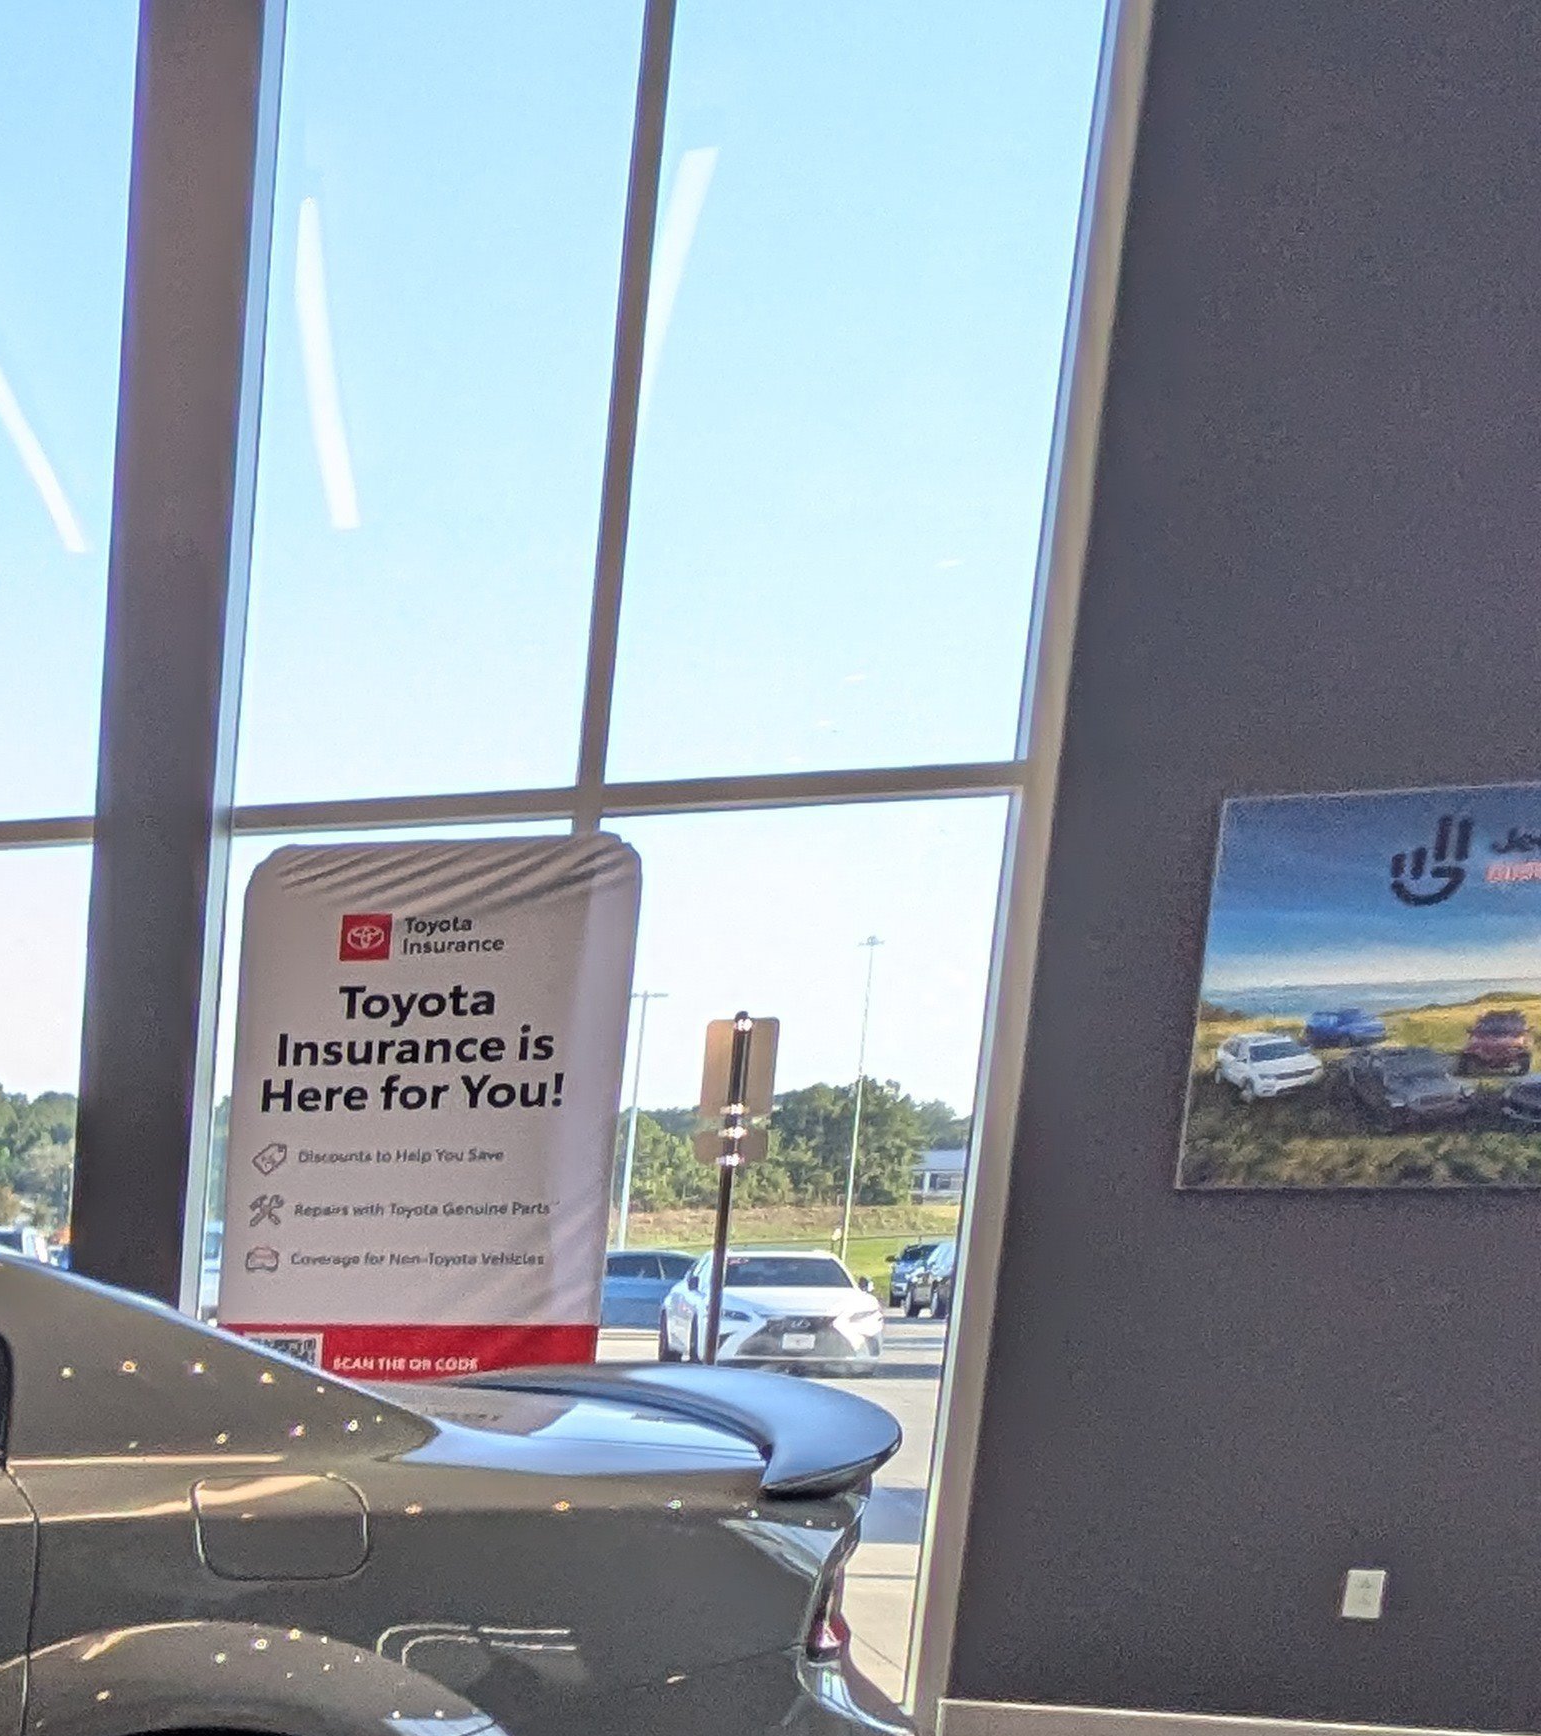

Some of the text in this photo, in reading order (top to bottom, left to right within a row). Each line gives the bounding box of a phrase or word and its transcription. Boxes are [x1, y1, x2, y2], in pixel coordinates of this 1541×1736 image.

[404, 916, 473, 936] Toyota
[403, 938, 505, 955] Insurance
[339, 985, 496, 1028] Toyota
[278, 1024, 555, 1066] Insurance is
[262, 1072, 565, 1112] Here for You!
[298, 1148, 504, 1164] Discounts to Help You Save
[294, 1203, 348, 1218] Repairs
[353, 1203, 384, 1216] with
[391, 1203, 438, 1219] Toyota
[442, 1202, 508, 1217] Genuine
[290, 1252, 544, 1268] Coverage for Non-Toyota Vehicles
[333, 1357, 478, 1371] SCAN THE QR CODE
